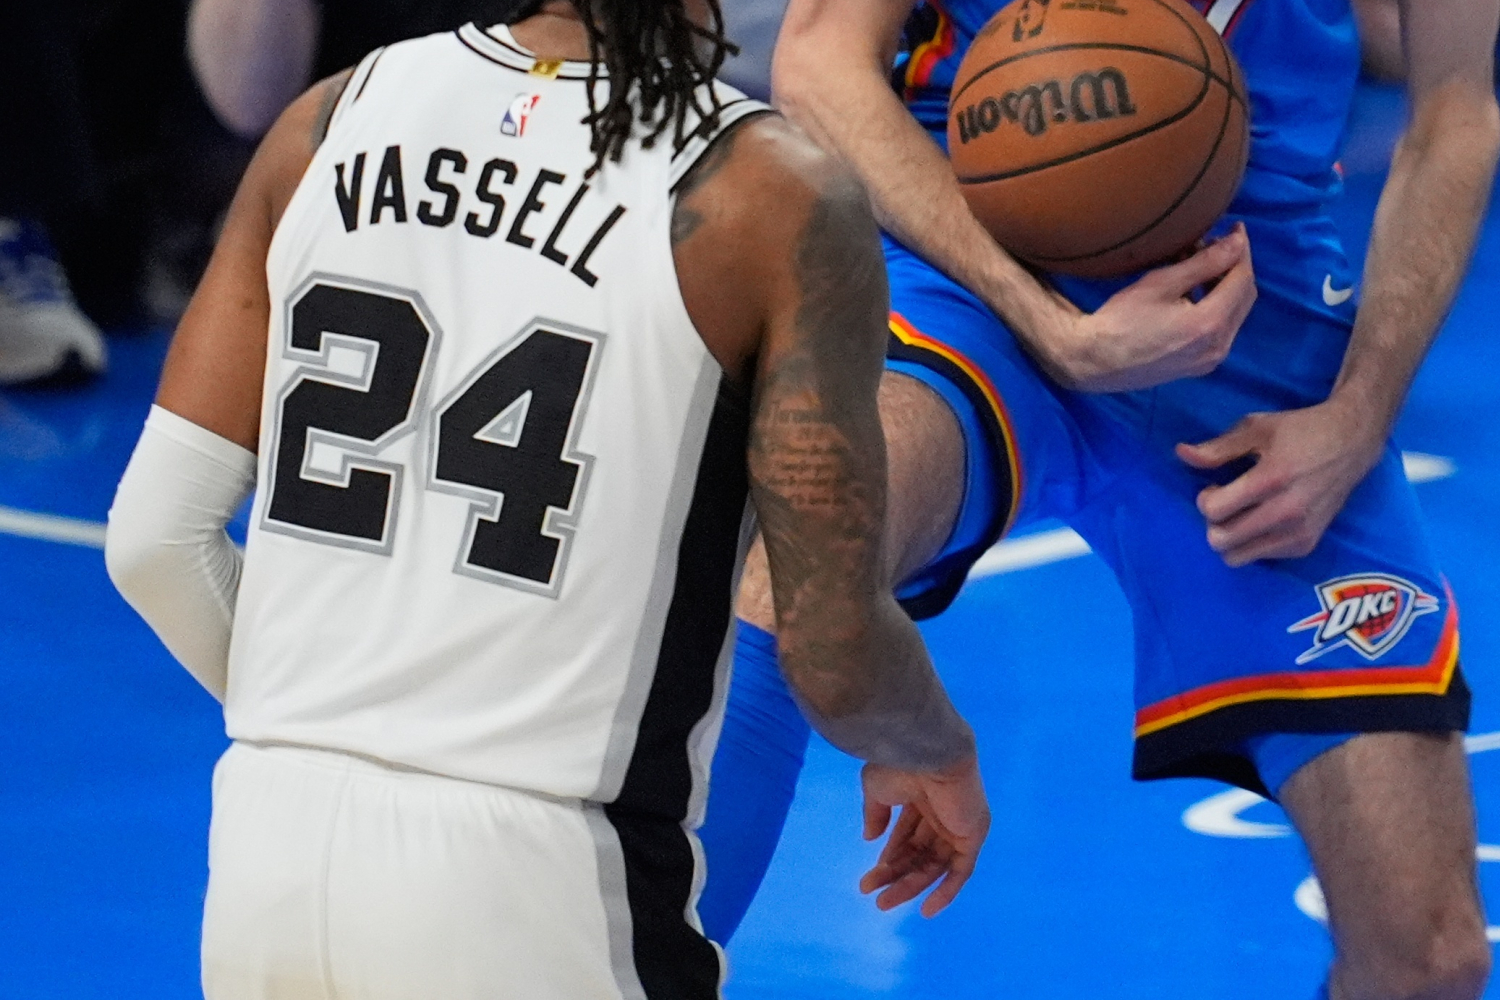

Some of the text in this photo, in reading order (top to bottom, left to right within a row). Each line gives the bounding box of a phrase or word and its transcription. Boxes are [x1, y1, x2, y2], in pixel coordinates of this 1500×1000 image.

[956, 66, 1136, 144] Wilson
[334, 144, 627, 288] VASSELL
[259, 270, 608, 600] 24
[1319, 589, 1399, 641] OKC
